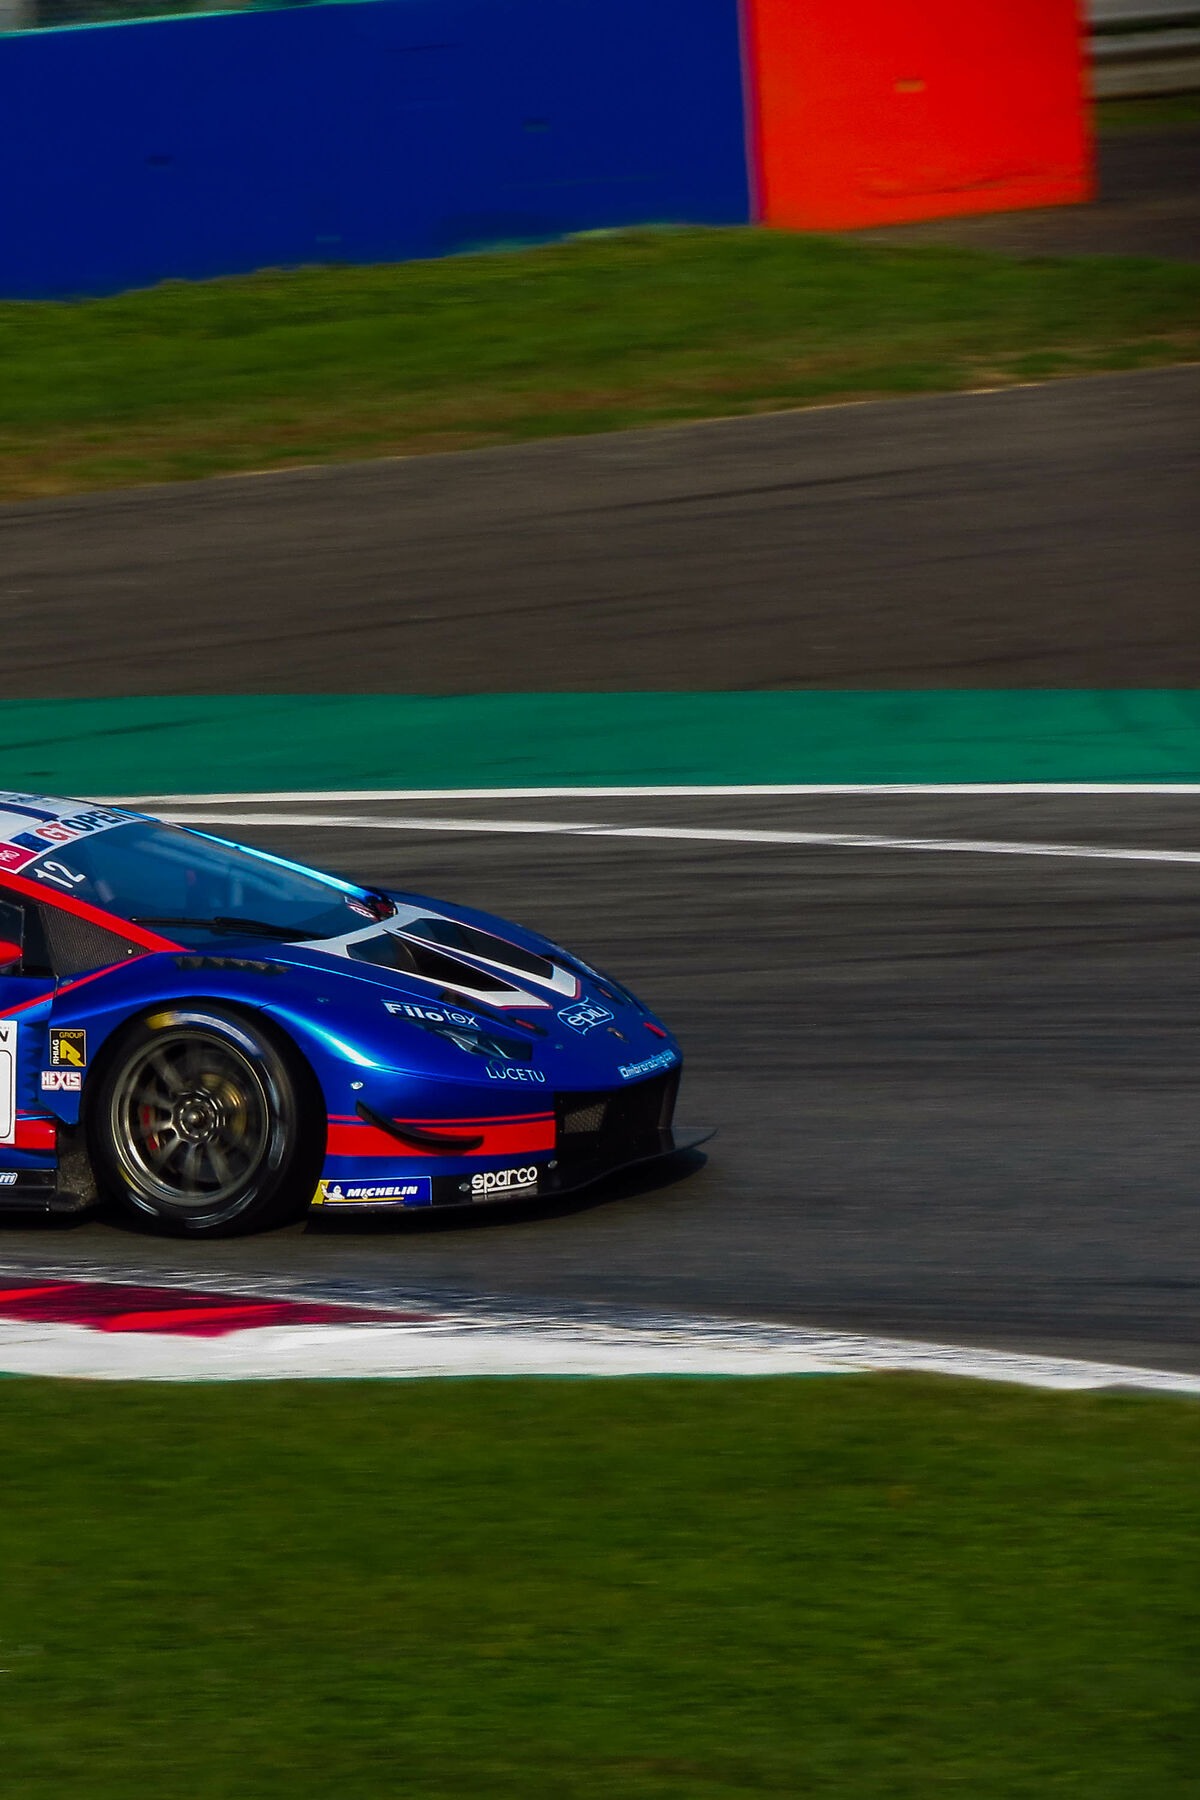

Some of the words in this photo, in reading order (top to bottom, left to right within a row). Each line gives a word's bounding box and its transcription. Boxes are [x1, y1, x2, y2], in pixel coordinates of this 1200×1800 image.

[34, 861, 87, 889] 12
[41, 1070, 82, 1091] HEXIS
[346, 1185, 418, 1198] MICHELIN
[471, 1166, 539, 1194] sparco
